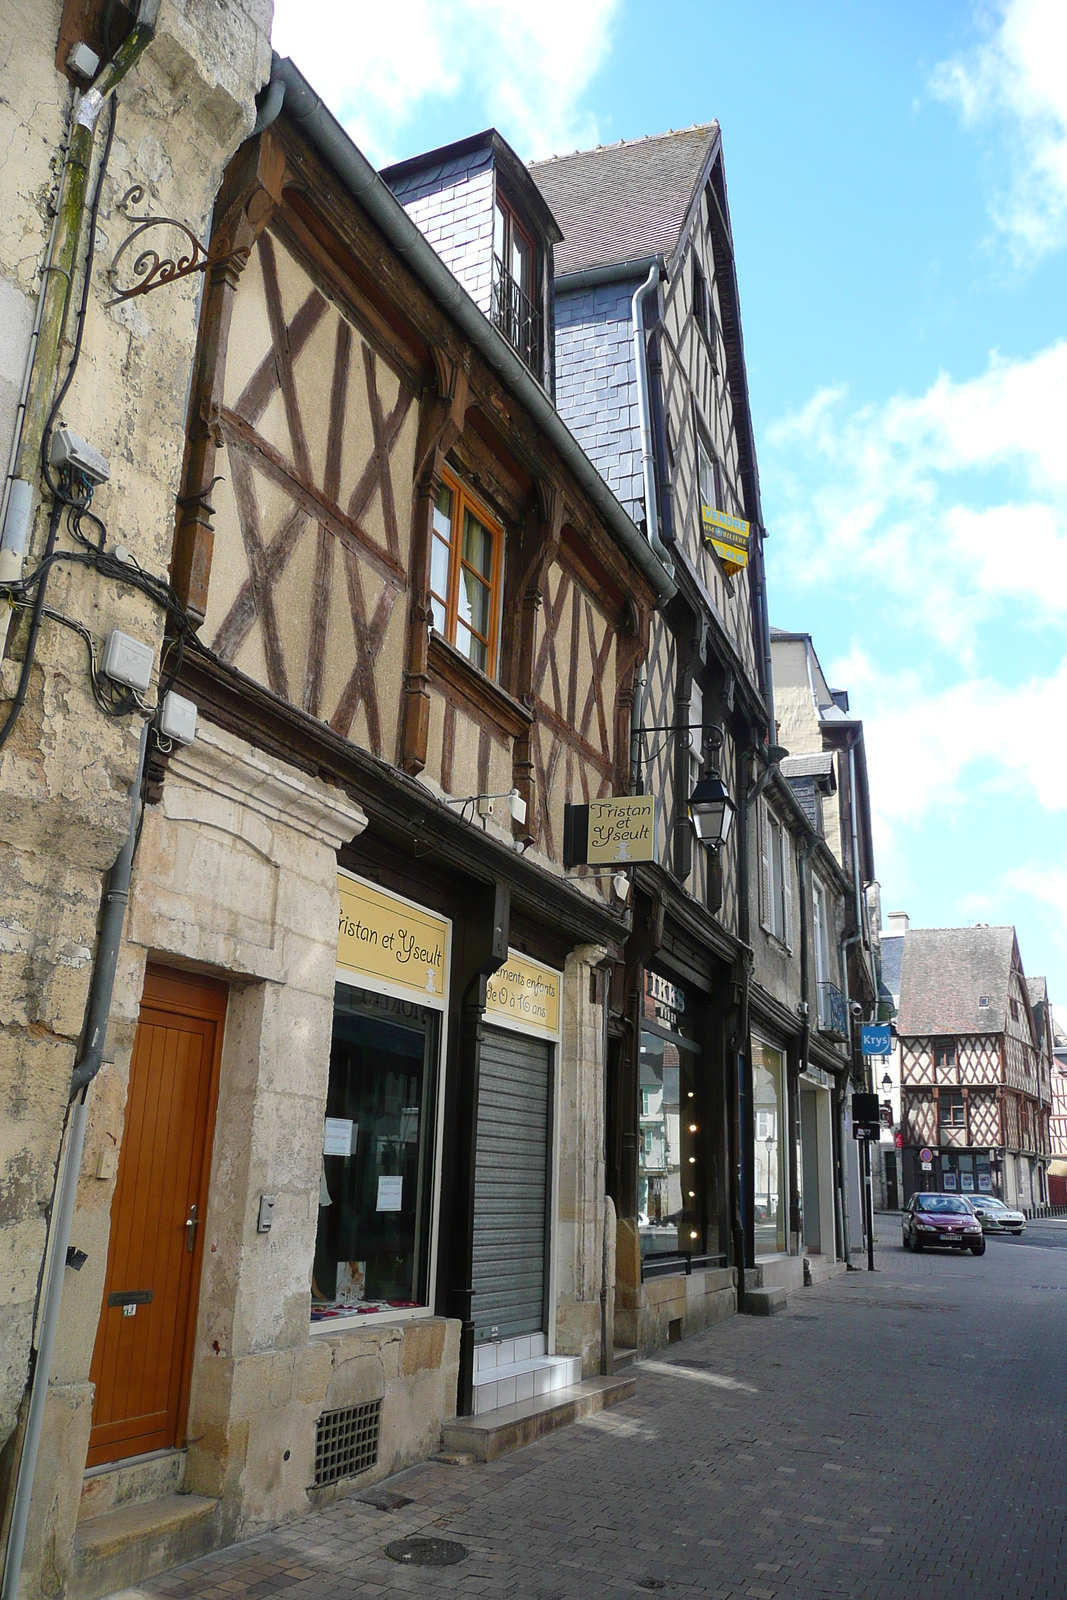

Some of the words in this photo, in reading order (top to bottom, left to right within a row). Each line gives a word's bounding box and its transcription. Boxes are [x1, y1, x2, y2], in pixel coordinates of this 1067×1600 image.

[704, 507, 747, 532] VENDRE
[590, 803, 651, 818] Tristan
[616, 817, 631, 828] et
[591, 824, 650, 847] Yseult
[338, 907, 378, 944] ristan
[381, 932, 395, 950] et
[396, 929, 442, 967] Yseult
[495, 968, 525, 986] ements
[526, 975, 556, 997] enfants
[486, 981, 497, 1001] de
[509, 992, 515, 1007] à
[517, 994, 530, 1012] 16
[532, 1004, 546, 1018] ans
